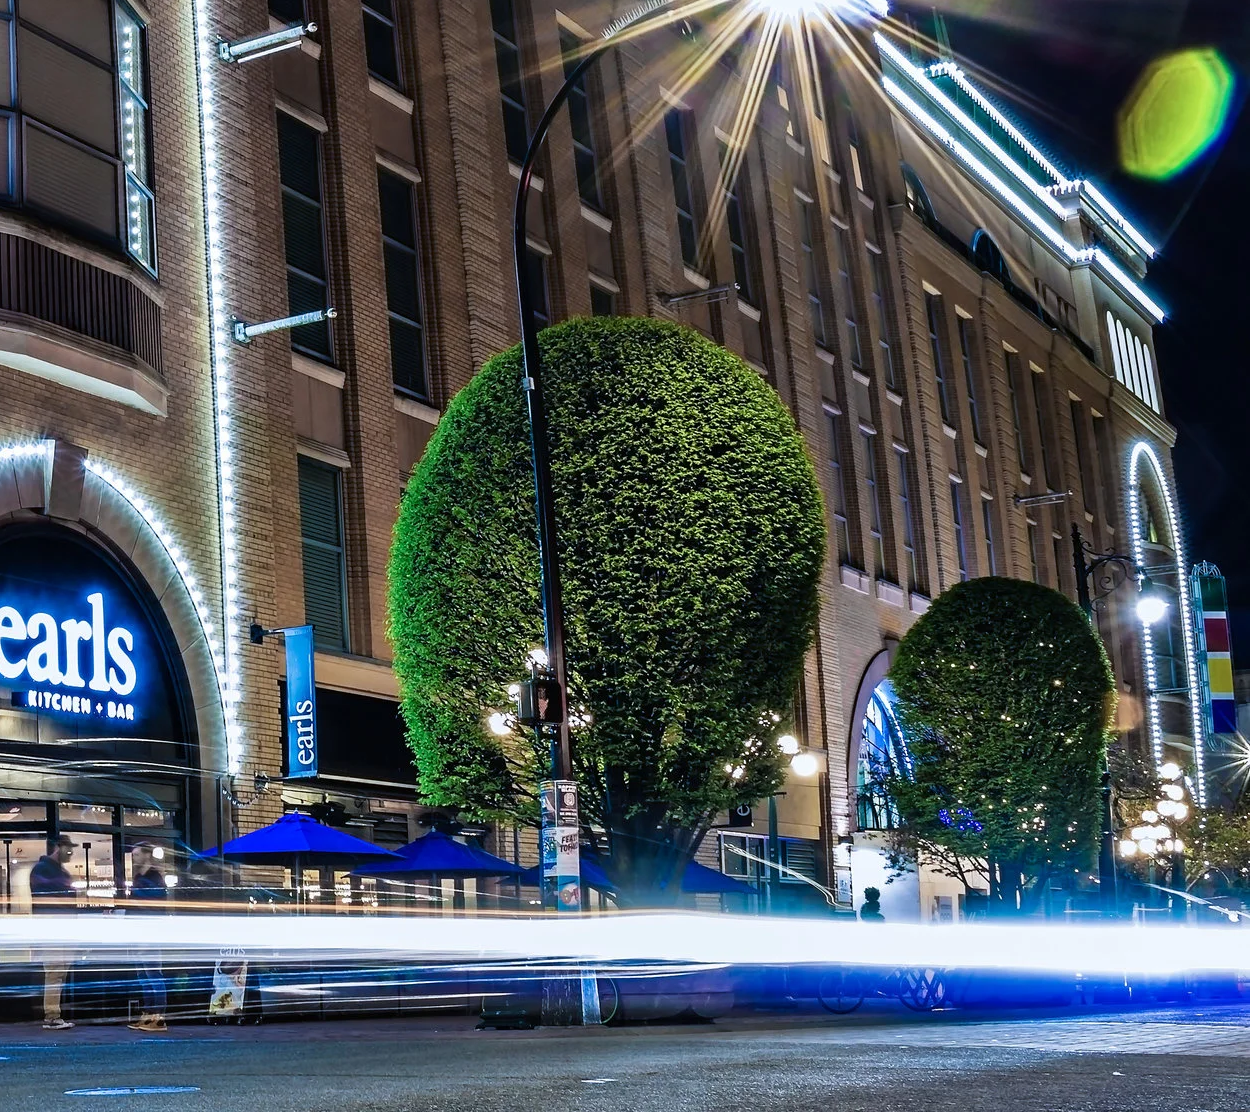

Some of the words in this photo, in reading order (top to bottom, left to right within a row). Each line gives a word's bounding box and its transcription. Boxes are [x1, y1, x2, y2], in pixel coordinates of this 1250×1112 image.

[28, 690, 91, 714] KITCHEN
[108, 701, 135, 720] BAR
[289, 699, 314, 765] earls
